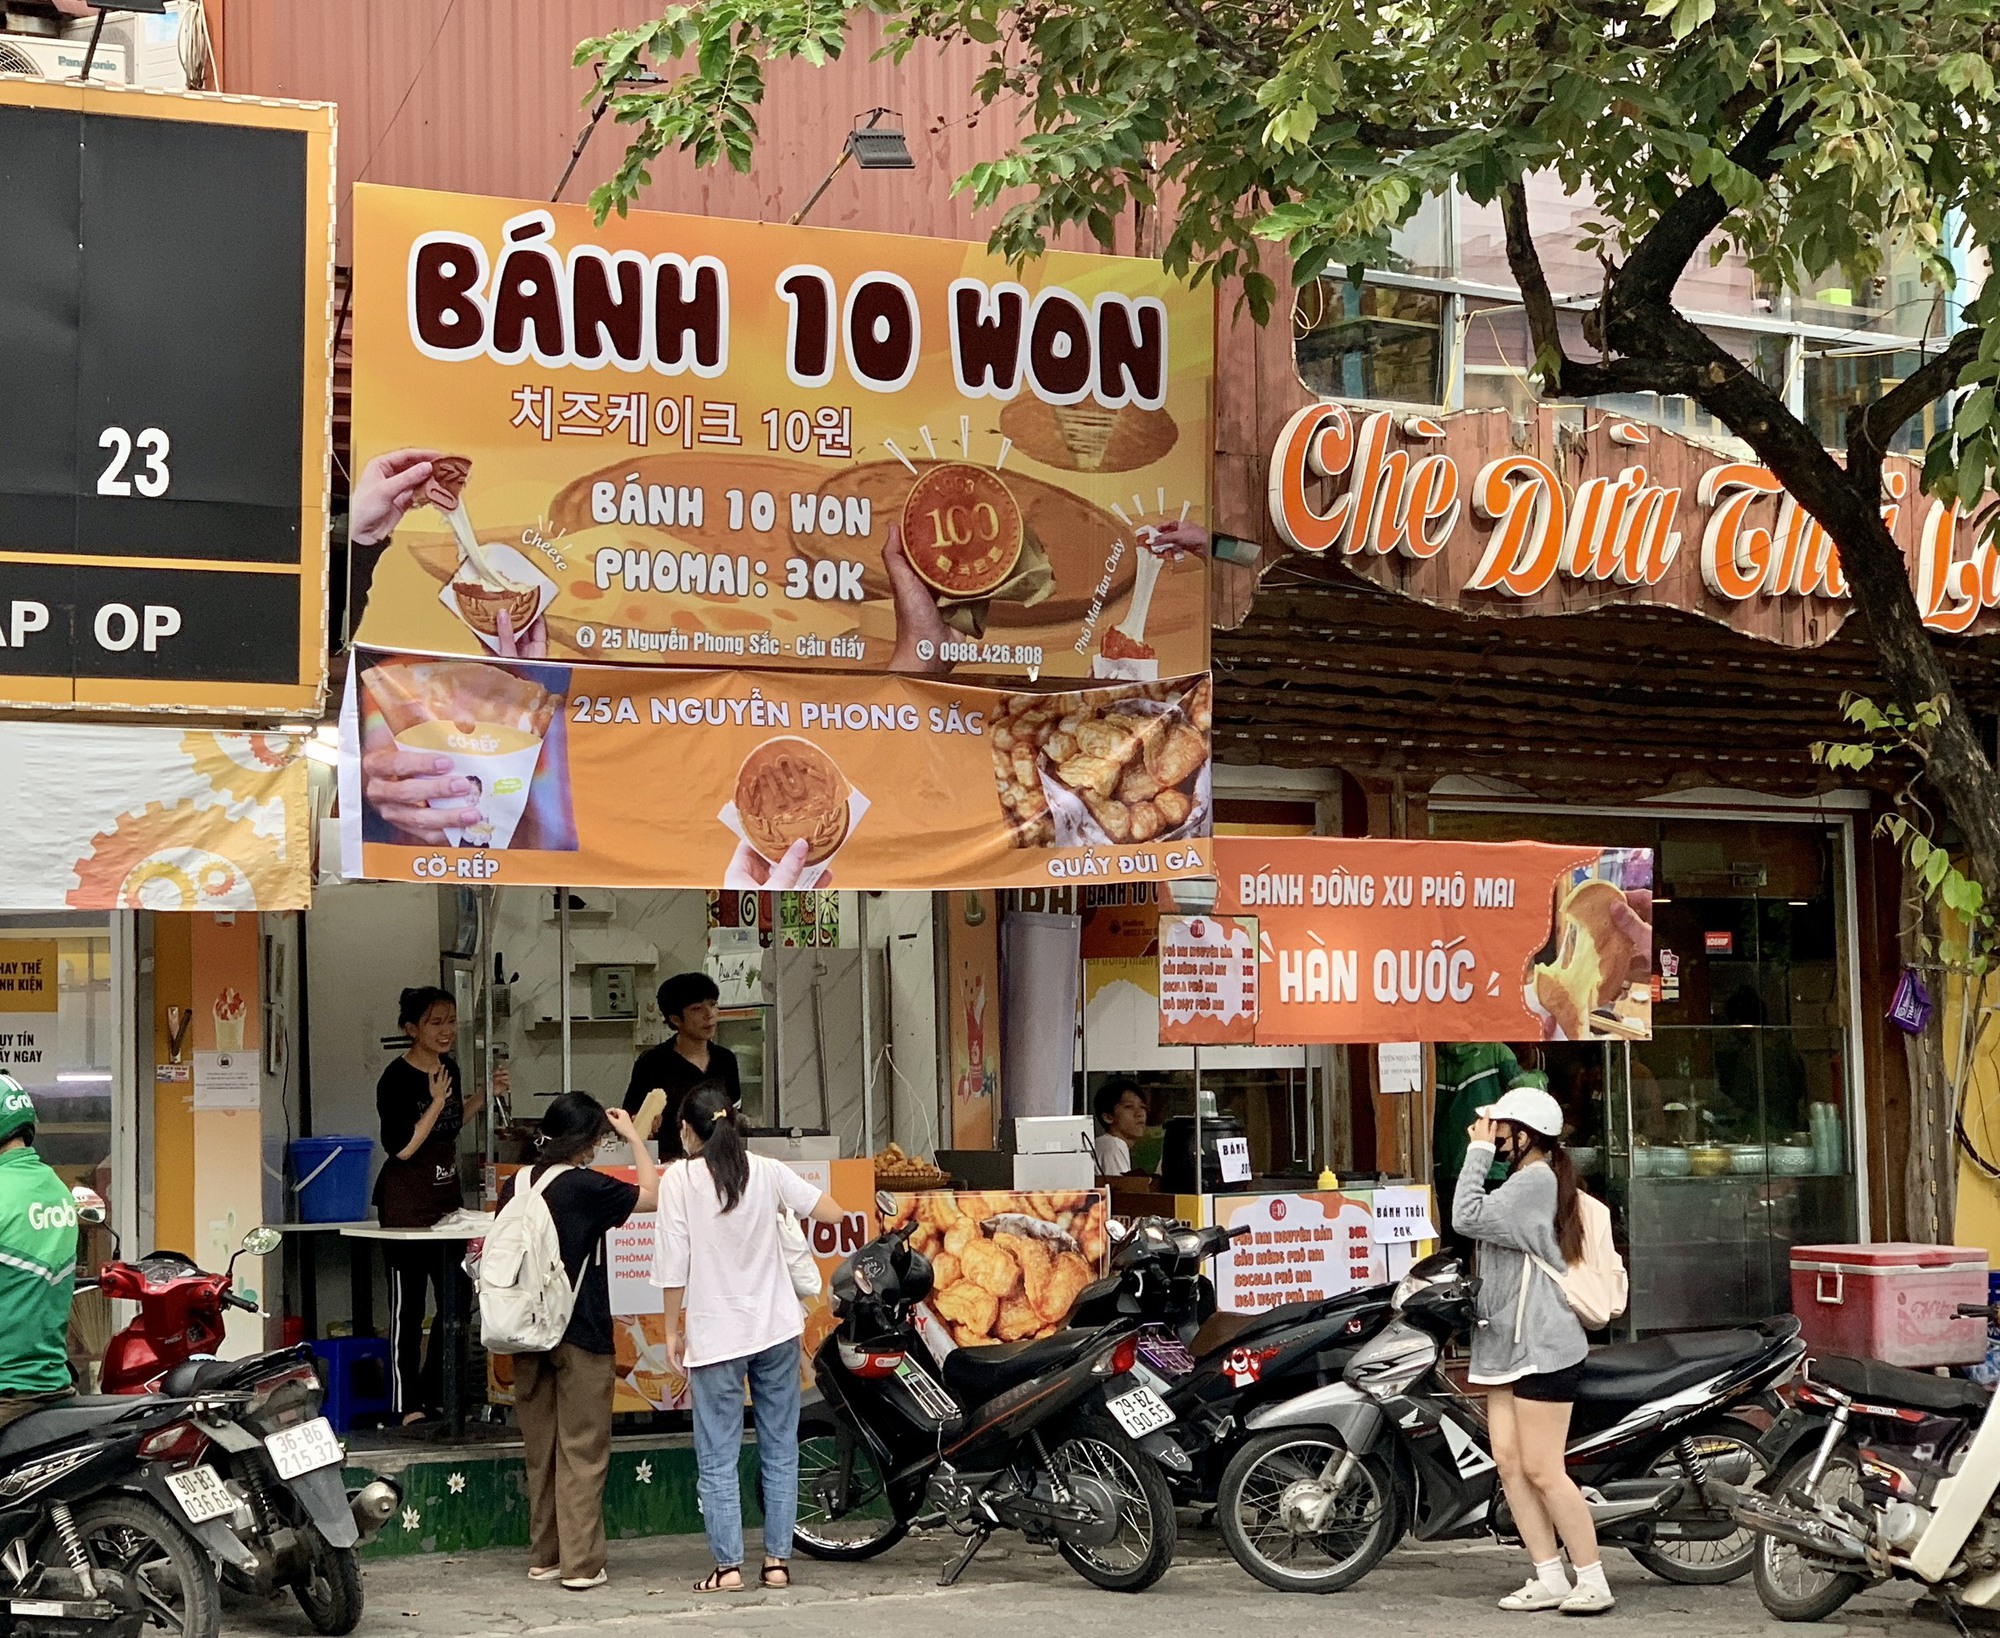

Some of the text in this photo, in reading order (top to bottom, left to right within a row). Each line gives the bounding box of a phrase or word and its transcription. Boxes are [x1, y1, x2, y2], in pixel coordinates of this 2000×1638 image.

[58, 55, 118, 72] Panaonic
[410, 210, 1167, 409] BÁNH 10 WON
[510, 384, 853, 458] 치즈케이크 10원
[97, 426, 170, 497] 23
[591, 472, 872, 537] BÁNH 10 WON
[1269, 402, 1461, 560] Chè
[1460, 423, 1682, 598] Dừa
[521, 528, 568, 573] Cheese
[594, 547, 866, 602] PHOMAI: 30K
[94, 603, 182, 652] OP
[1074, 626, 1092, 656] Phô
[1085, 597, 1102, 628] Mai
[1095, 574, 1112, 598] Tan
[601, 628, 622, 650] 25
[626, 626, 689, 655] Nguyễn
[693, 634, 744, 656] Phong
[749, 630, 780, 655] Sắc
[795, 634, 826, 657] Cầu
[830, 635, 865, 660] Giấy
[939, 642, 1042, 665] 0988.426.808
[572, 687, 984, 736] 25A NGUYỄN PHONG SẮC
[412, 850, 499, 878] CỜ-RẾP
[1047, 845, 1203, 878] QUẨY ĐÙI GÀ
[1240, 863, 1516, 909] BÁNH ĐỒNG XU PHÔ MAI
[21, 958, 43, 975] THẾ
[1279, 929, 1476, 1005] HÀN QUỐC
[18, 975, 43, 994] KIỆN
[16, 1031, 34, 1047] TÍN
[14, 1050, 43, 1063] NGAY
[6, 1094, 34, 1111] Gra
[28, 1198, 77, 1231] Grab
[1376, 1205, 1401, 1218] BÁNH
[1393, 1227, 1413, 1238] 20K
[615, 1269, 651, 1279] PHÔMA
[1126, 1404, 1170, 1433] 190.55
[1868, 1406, 1896, 1415] HONDA
[276, 1425, 323, 1453] 36-B6
[280, 1442, 335, 1475] 215.37
[175, 1467, 216, 1495] 90-B3
[185, 1490, 233, 1519] 036.69
